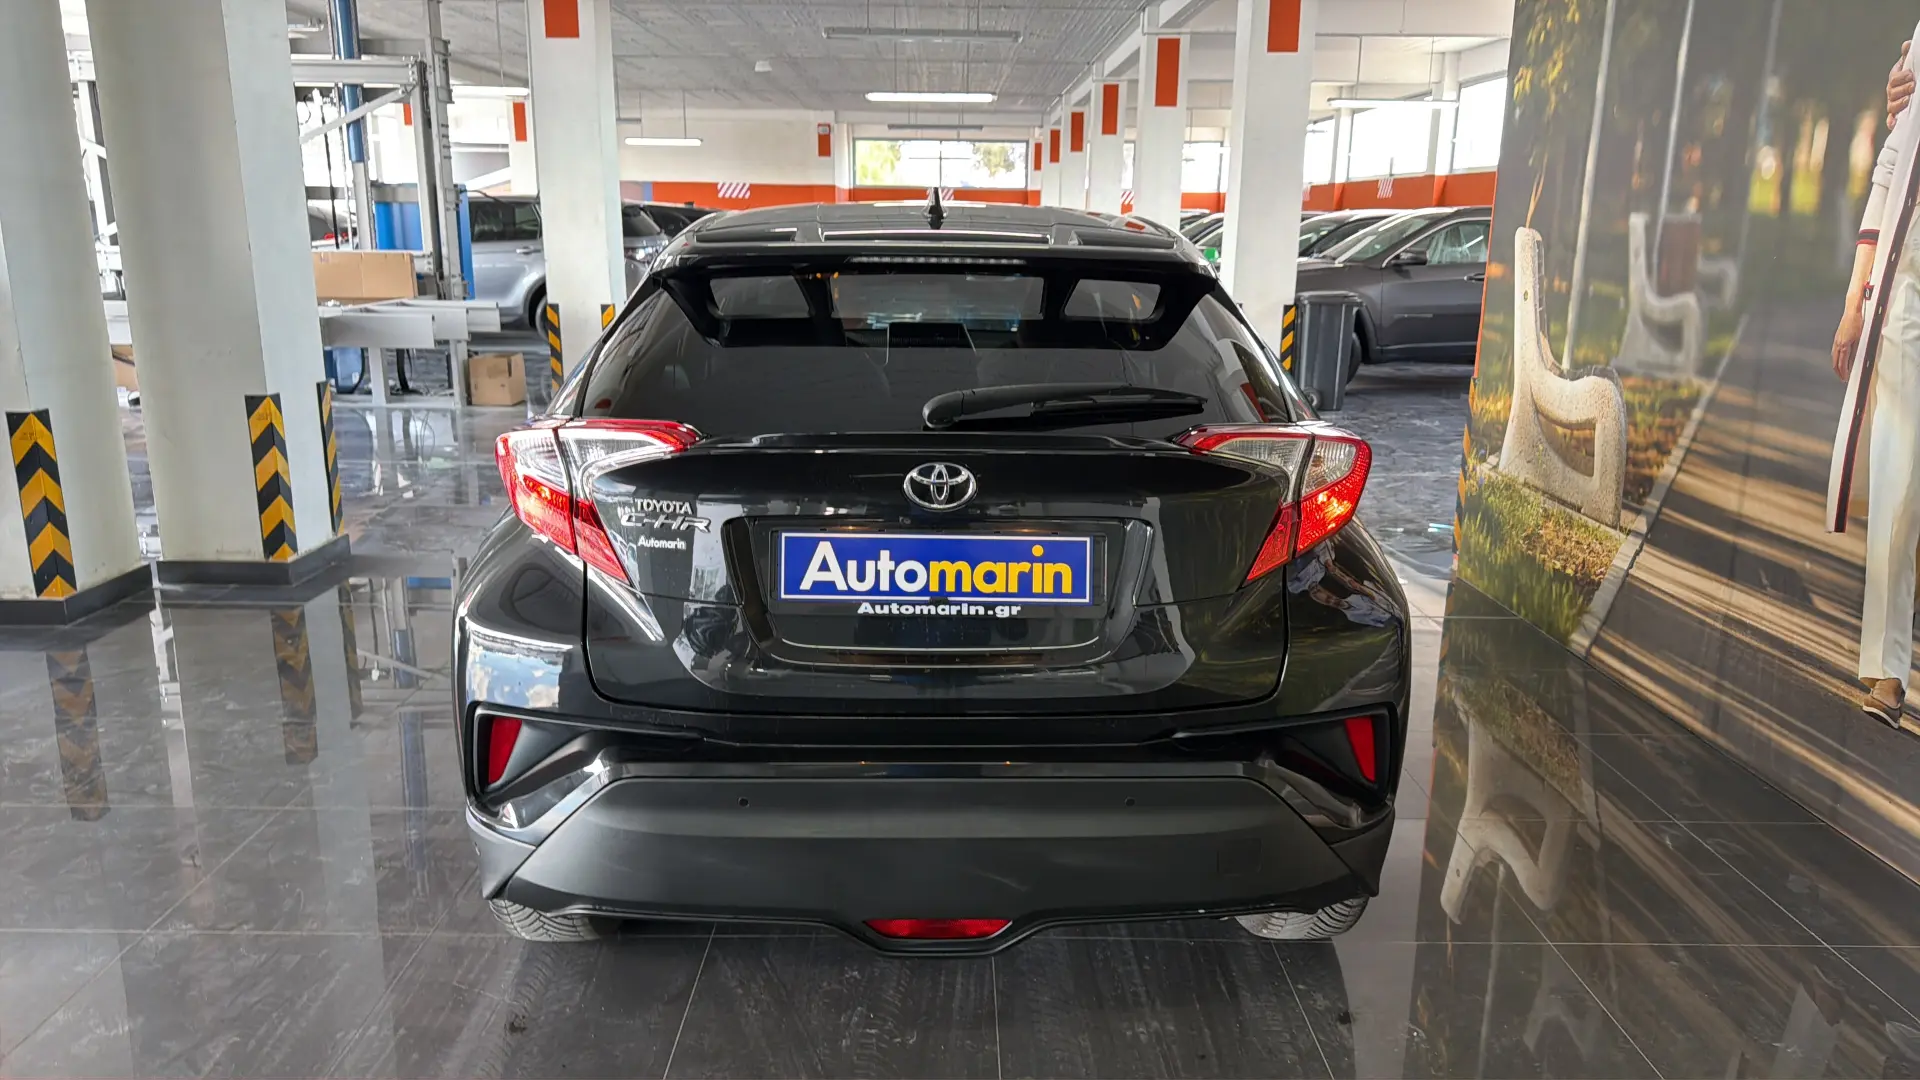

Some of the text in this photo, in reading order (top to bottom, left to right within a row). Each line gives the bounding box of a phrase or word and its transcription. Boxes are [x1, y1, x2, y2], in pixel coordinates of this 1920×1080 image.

[635, 499, 693, 514] TOYOTA
[620, 513, 711, 533] C-HR
[637, 535, 687, 550] Automarin
[799, 540, 1073, 594] Automarin
[857, 602, 1022, 618] Automarin.gr
